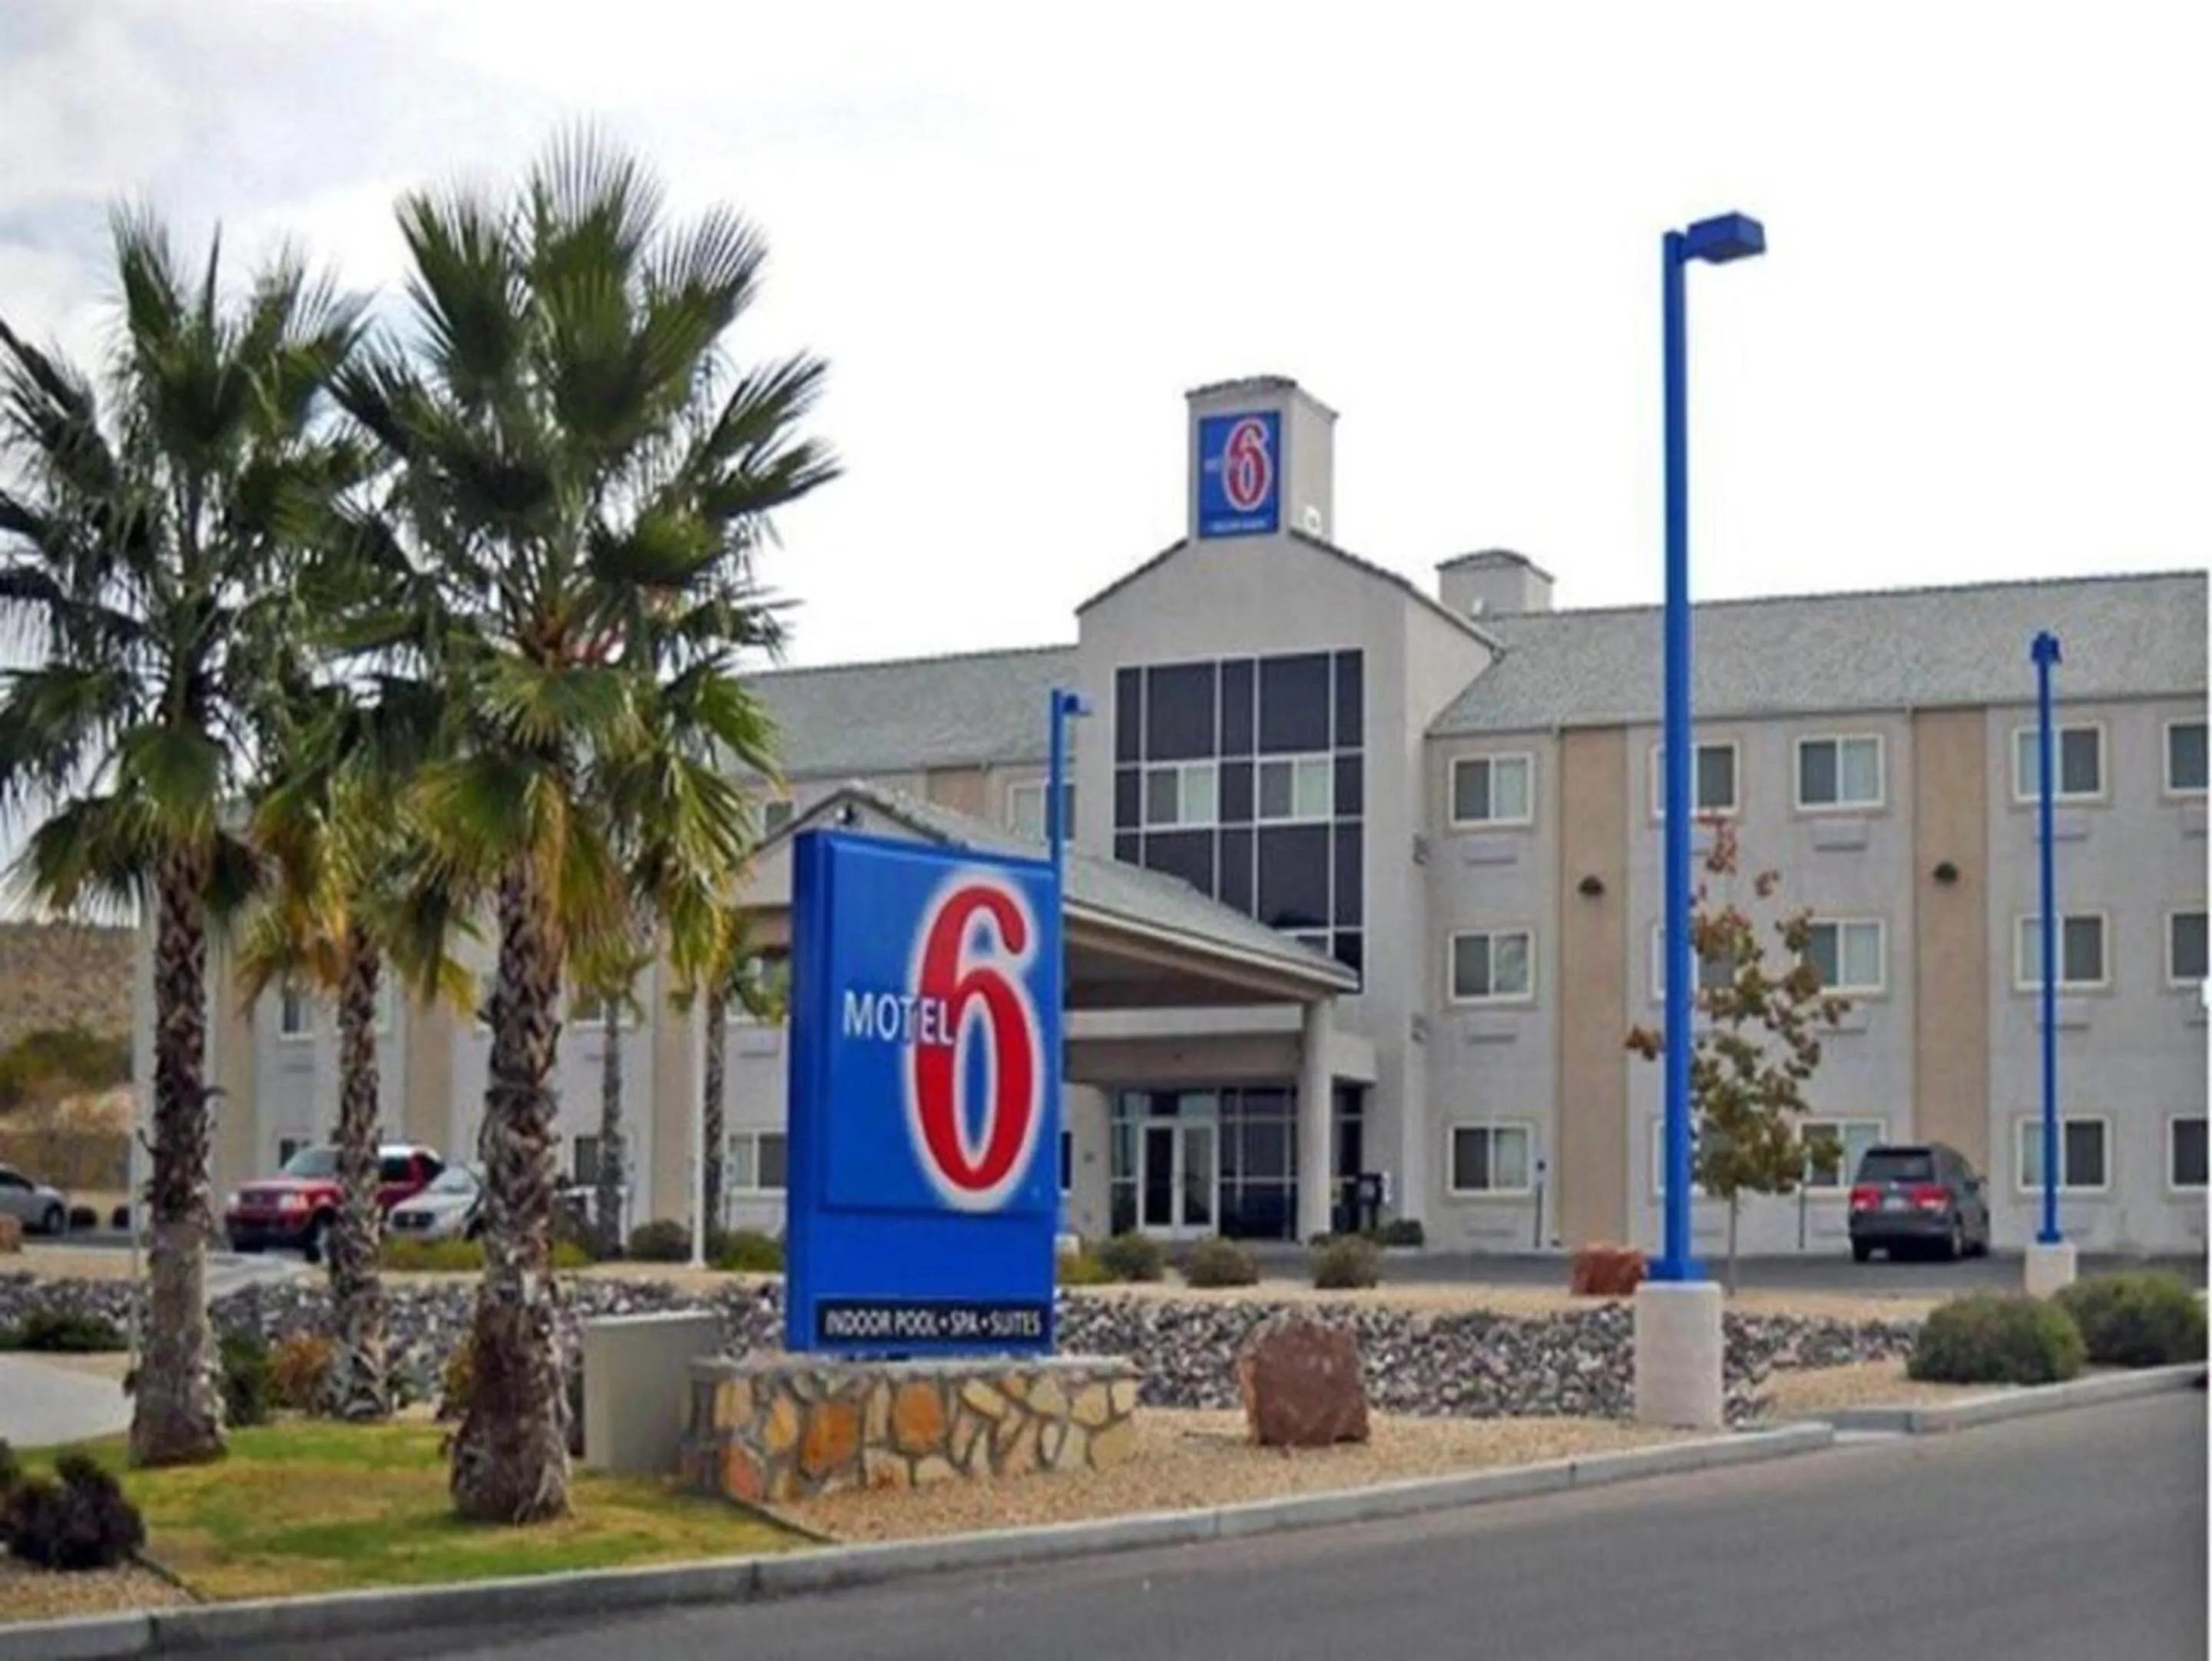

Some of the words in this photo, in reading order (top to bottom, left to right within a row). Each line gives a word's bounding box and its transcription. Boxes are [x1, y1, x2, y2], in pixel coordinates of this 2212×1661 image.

[1224, 419, 1273, 511] 6
[843, 990, 955, 1046] MOTEL
[909, 874, 1039, 1203] 6
[824, 1309, 889, 1335] INDOOR
[894, 1310, 938, 1336] POOL
[949, 1310, 979, 1336] SPA
[990, 1310, 1041, 1336] SUITES
